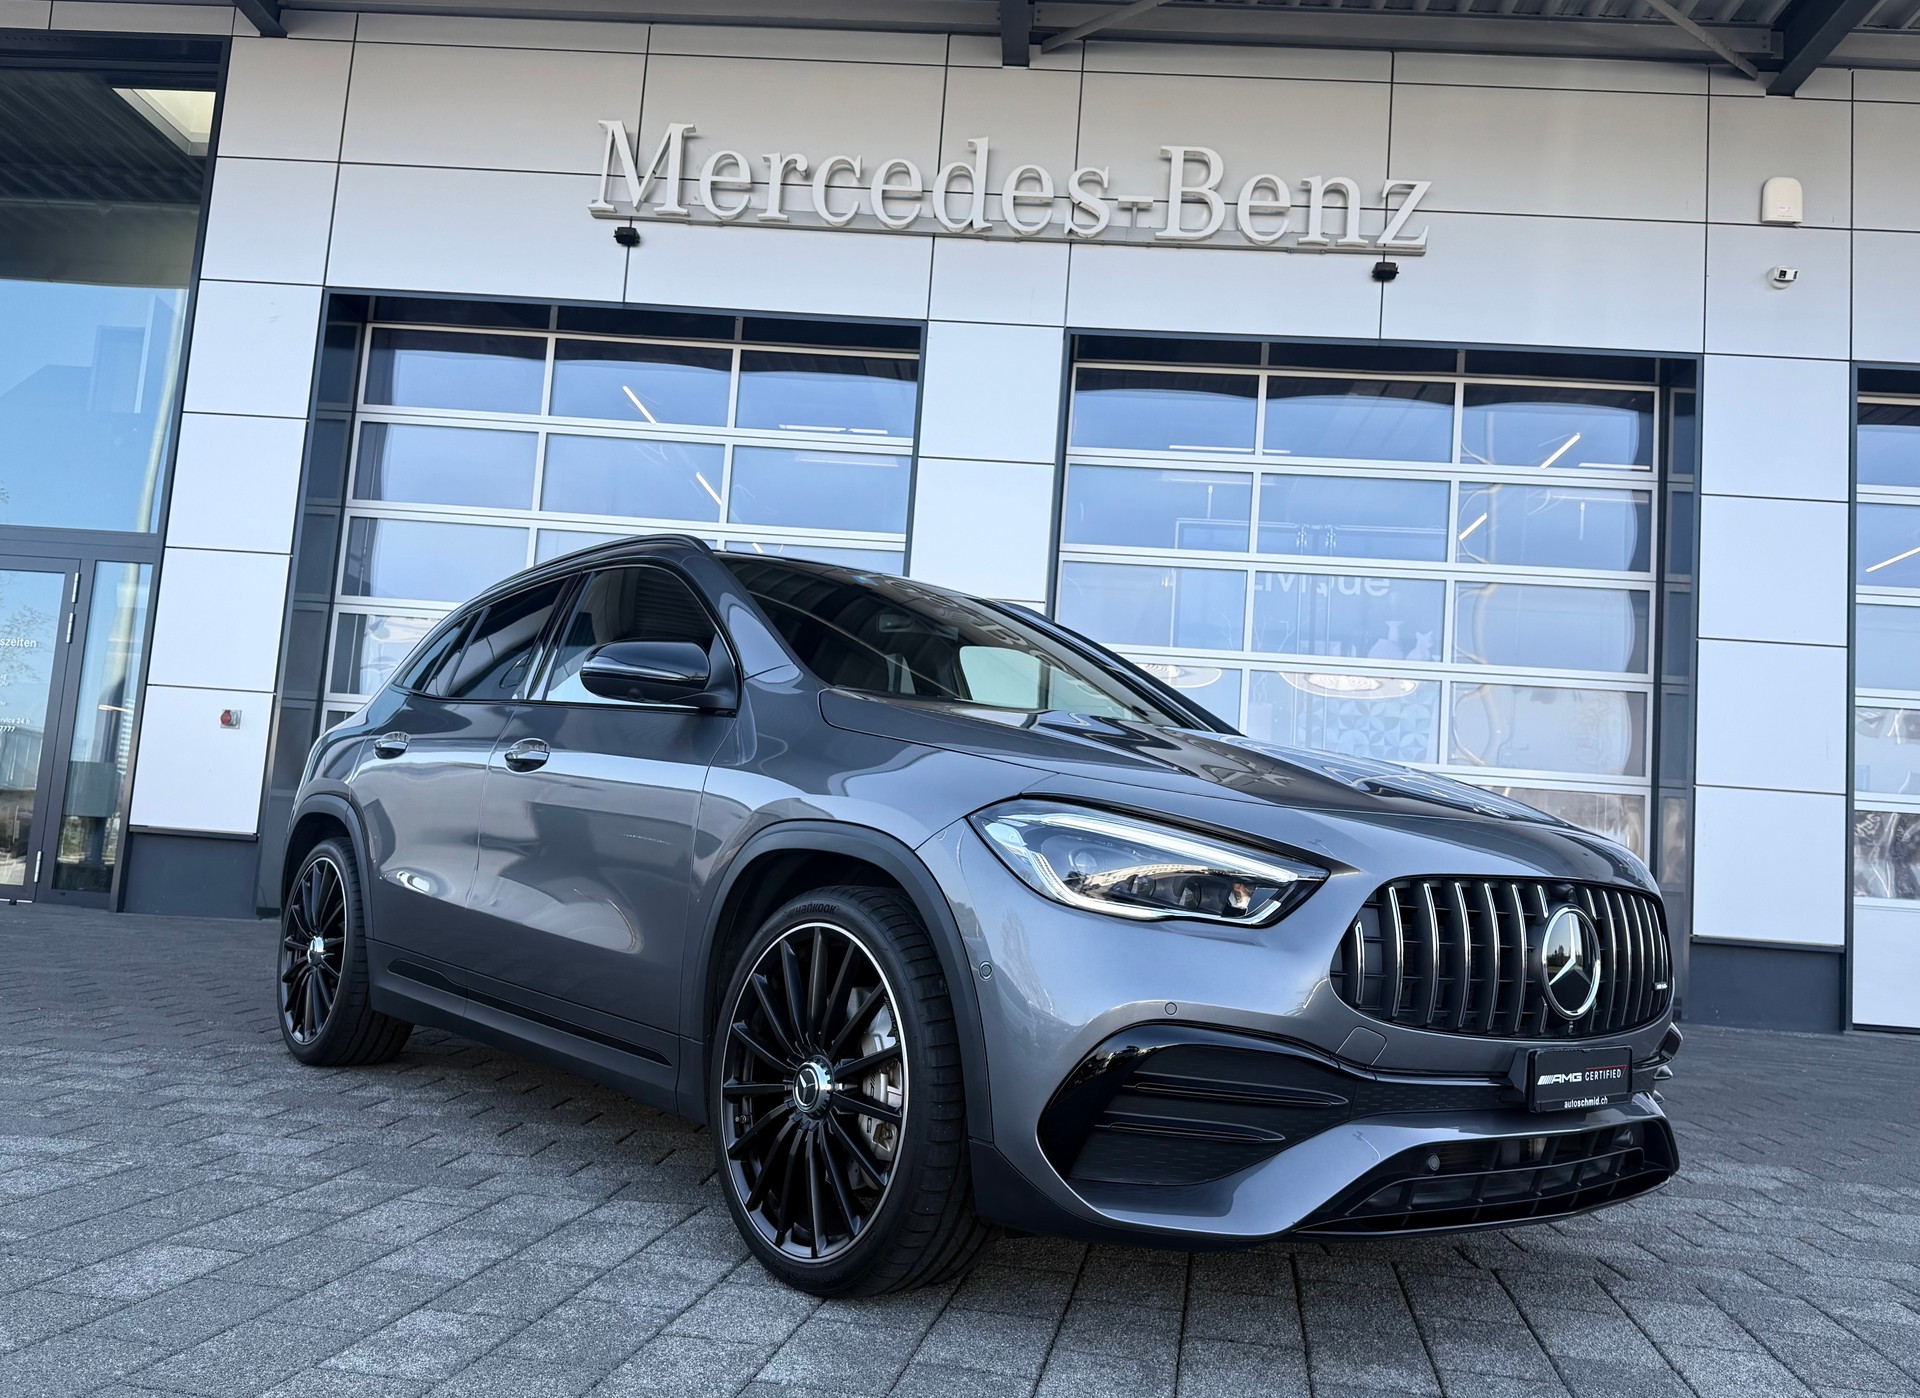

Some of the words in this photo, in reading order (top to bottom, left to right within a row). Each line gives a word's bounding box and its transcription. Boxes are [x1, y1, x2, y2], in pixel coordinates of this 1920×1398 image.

[588, 119, 1432, 248] Mercedes-Benz
[1552, 1072, 1583, 1084] AMG
[1585, 1069, 1622, 1082] CERTIFIED
[1564, 1096, 1608, 1109] autoschmid.ch
